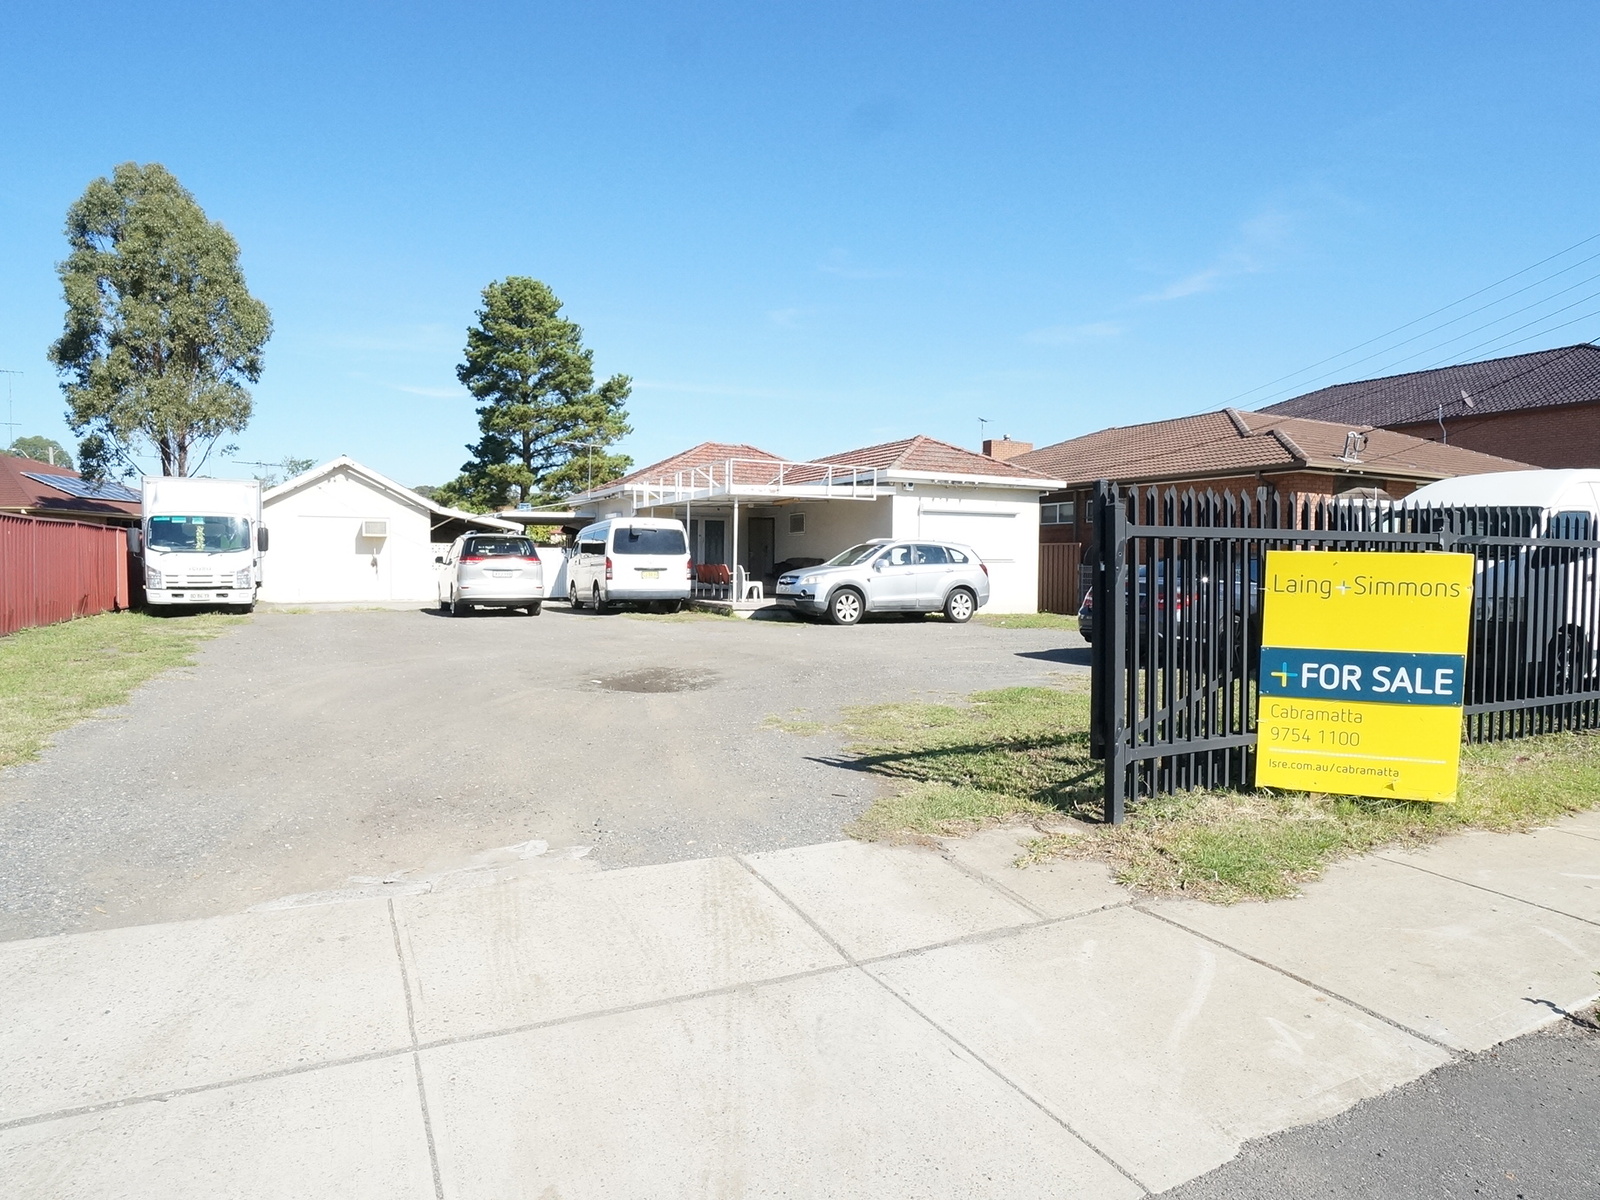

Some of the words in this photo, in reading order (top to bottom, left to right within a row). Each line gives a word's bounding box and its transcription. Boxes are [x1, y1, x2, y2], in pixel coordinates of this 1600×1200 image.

[1273, 574, 1332, 599] Laing
[1354, 576, 1461, 598] Simmons
[1301, 663, 1362, 692] FOR
[1372, 666, 1454, 695] SALE
[1270, 703, 1363, 724] Cabramatta
[1270, 726, 1311, 743] 9754
[1319, 730, 1360, 747] 1100
